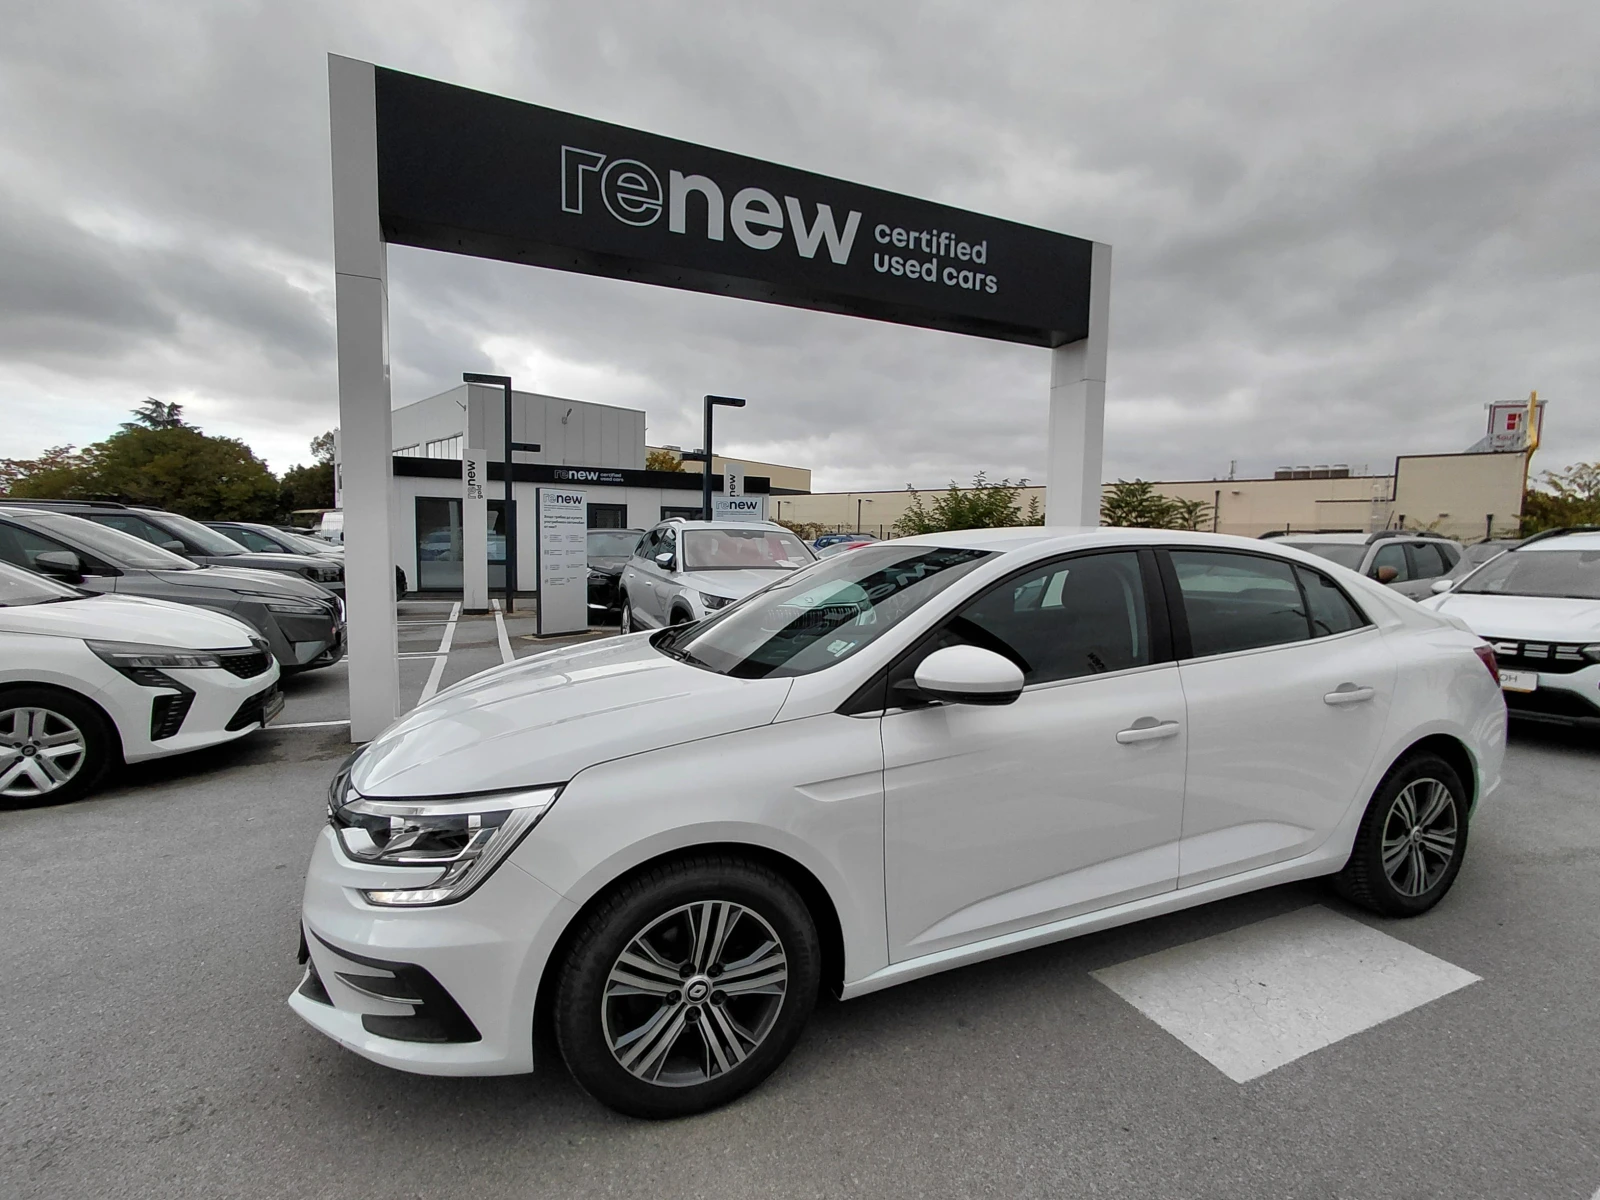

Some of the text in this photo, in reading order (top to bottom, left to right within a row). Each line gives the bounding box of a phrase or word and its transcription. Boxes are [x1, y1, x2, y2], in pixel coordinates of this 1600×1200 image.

[561, 145, 862, 265] renew
[874, 223, 987, 265] certified
[873, 251, 998, 294] used cars
[467, 459, 476, 500] renew
[554, 469, 599, 481] renew
[543, 493, 583, 505] renew
[716, 500, 758, 510] renew
